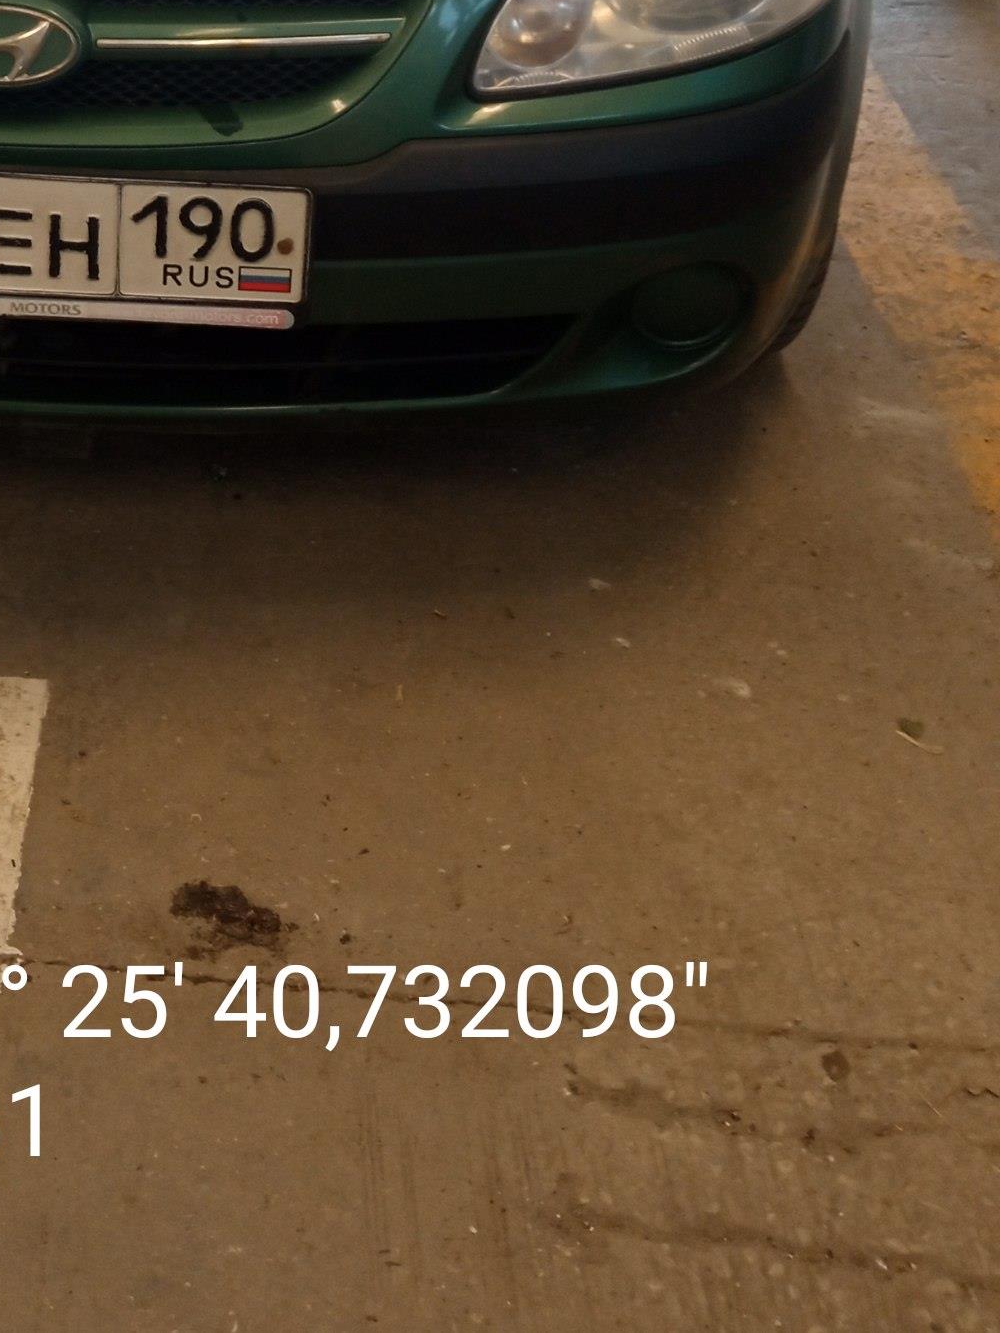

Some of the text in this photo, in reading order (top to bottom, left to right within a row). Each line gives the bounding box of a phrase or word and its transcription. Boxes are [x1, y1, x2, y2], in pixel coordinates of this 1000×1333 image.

[131, 195, 275, 263] 190
[162, 263, 235, 289] RUS
[9, 301, 82, 316] MOTORS
